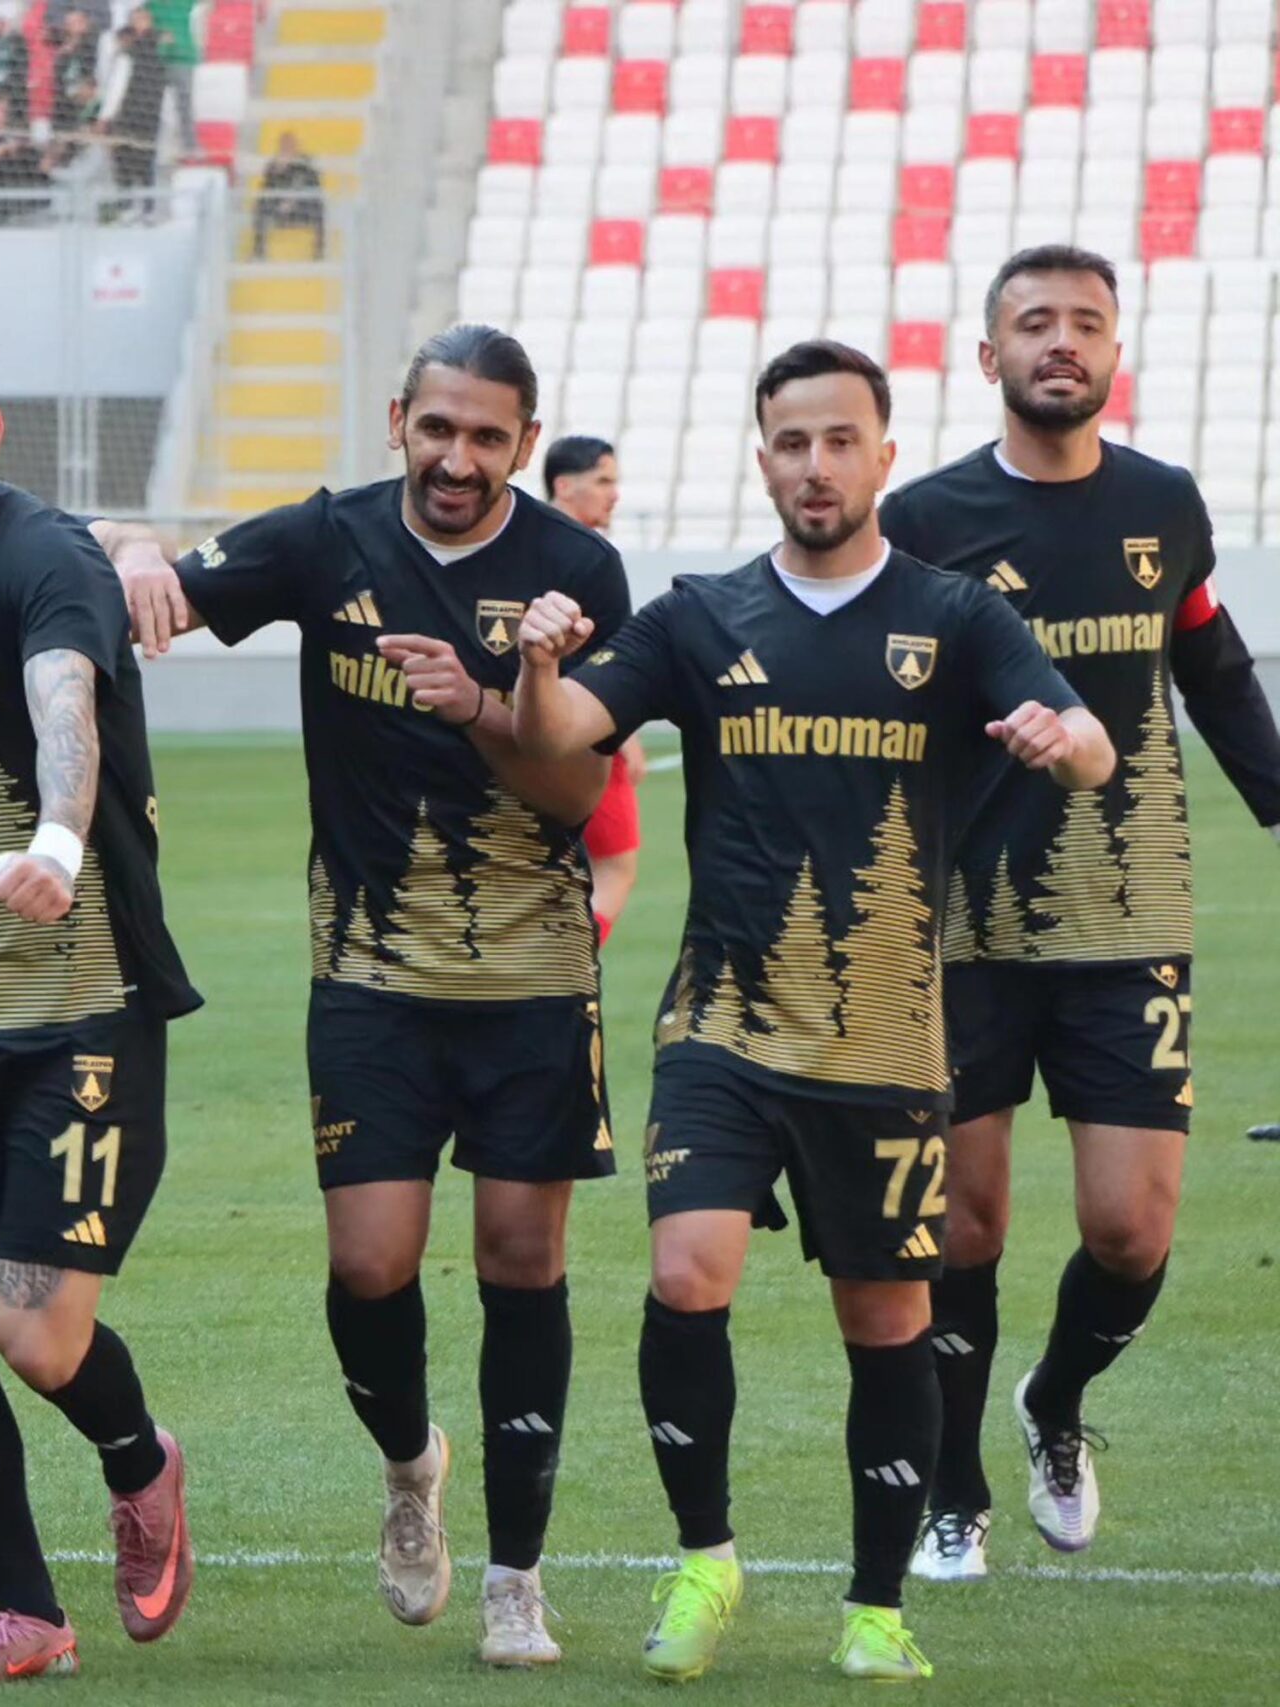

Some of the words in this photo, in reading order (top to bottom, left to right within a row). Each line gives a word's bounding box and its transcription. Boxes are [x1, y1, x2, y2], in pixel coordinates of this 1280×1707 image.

[1024, 613, 1165, 659] kroman
[720, 707, 928, 762] mikroman
[49, 1121, 122, 1208] 11
[874, 1135, 947, 1219] 72
